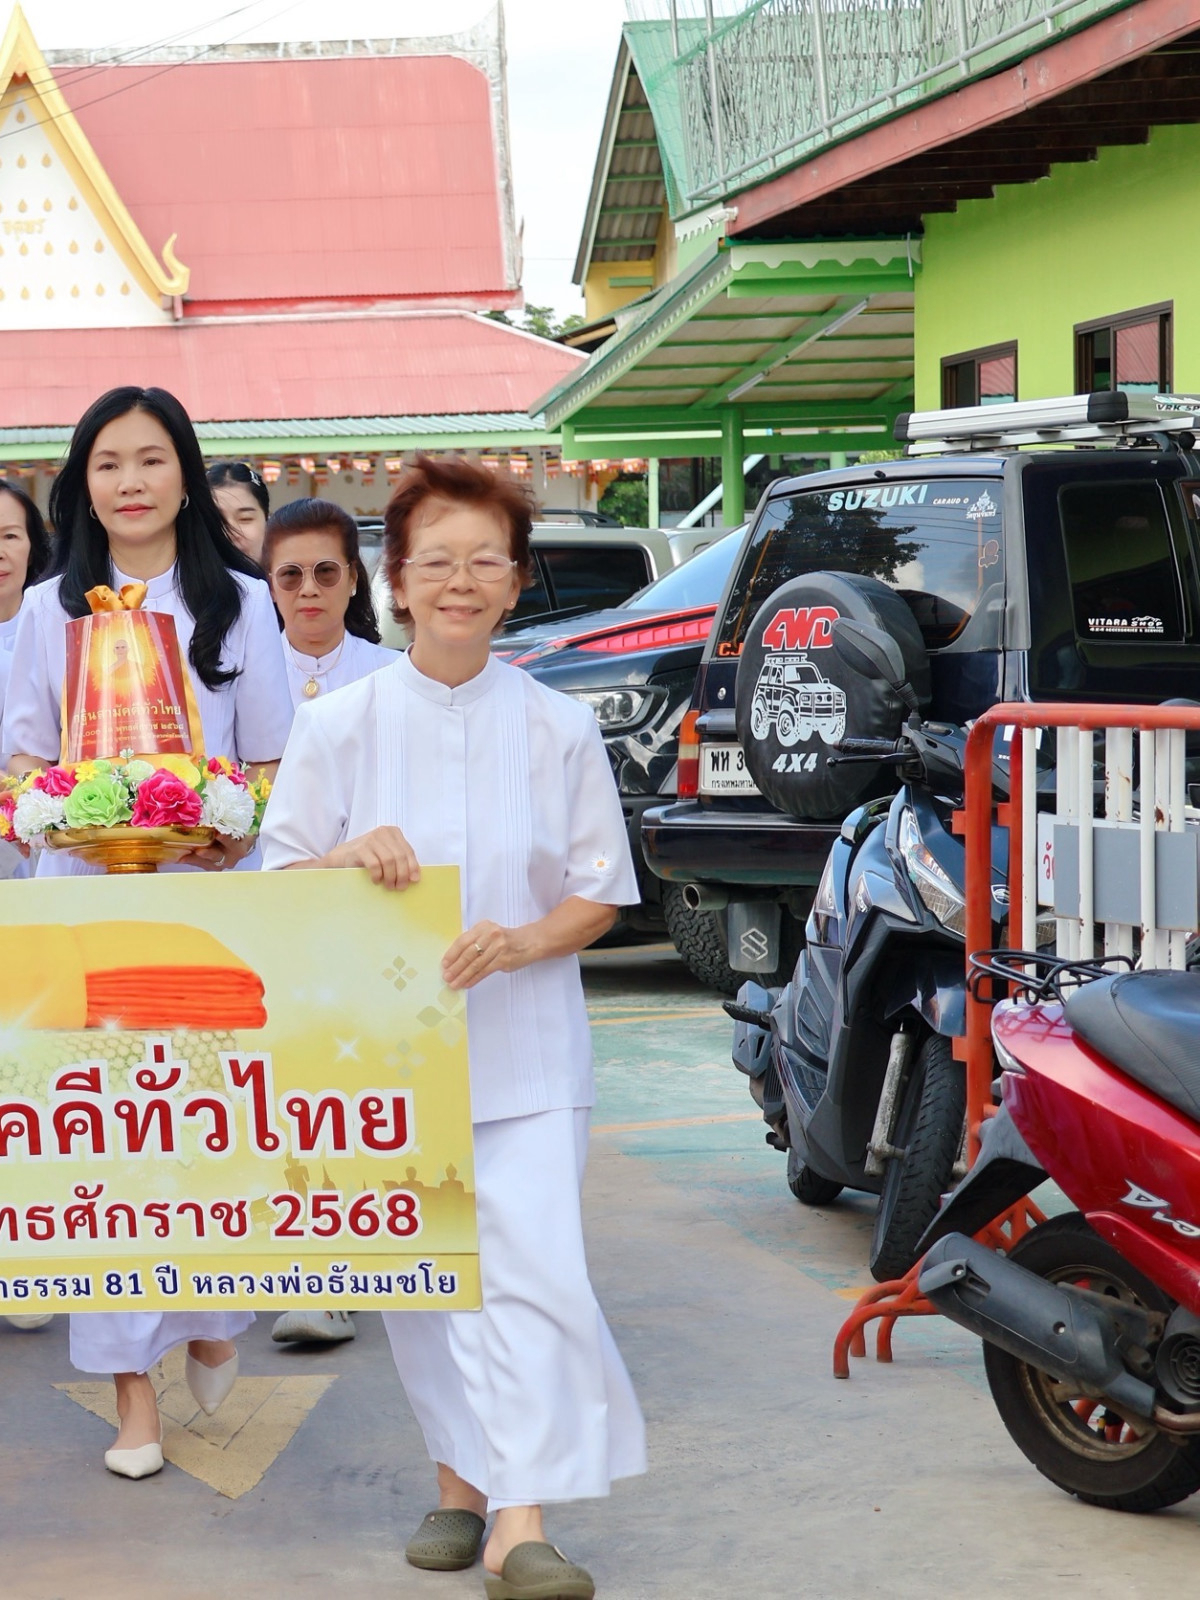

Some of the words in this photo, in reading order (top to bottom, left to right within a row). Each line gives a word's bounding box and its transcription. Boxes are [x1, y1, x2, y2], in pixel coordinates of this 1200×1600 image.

[827, 484, 929, 512] SUZUKI
[762, 605, 841, 651] 4WD
[1088, 618, 1128, 626] VITARA
[771, 752, 819, 773] 4X4
[272, 1193, 419, 1238] 2568
[105, 1272, 144, 1297] 81
[153, 1262, 180, 1296] ปี
[194, 1261, 458, 1296] หลวงพ่อธัมมชโย
